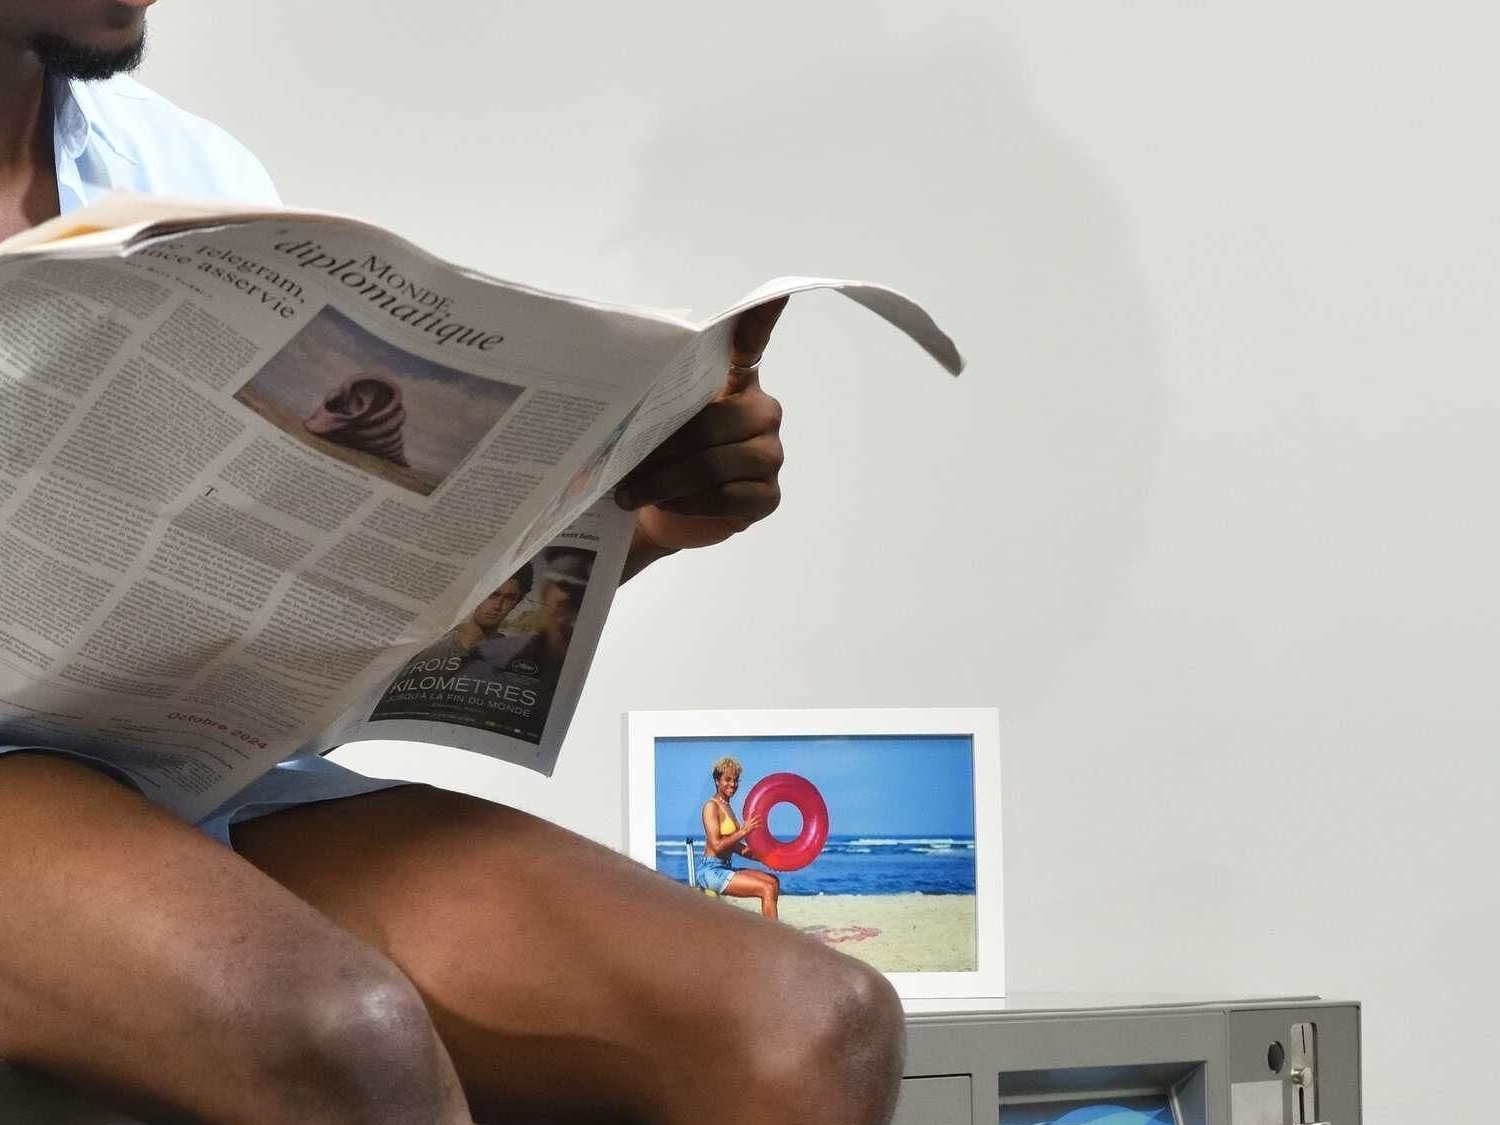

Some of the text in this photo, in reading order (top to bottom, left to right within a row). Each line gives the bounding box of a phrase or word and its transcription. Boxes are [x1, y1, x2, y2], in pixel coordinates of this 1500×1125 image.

[197, 261, 295, 318] asservie
[273, 238, 504, 353] diplomatique
[359, 254, 452, 312] MONDE
[166, 711, 269, 749] Octobre 2024
[446, 694, 465, 705] FIN
[488, 701, 531, 718] MONDE
